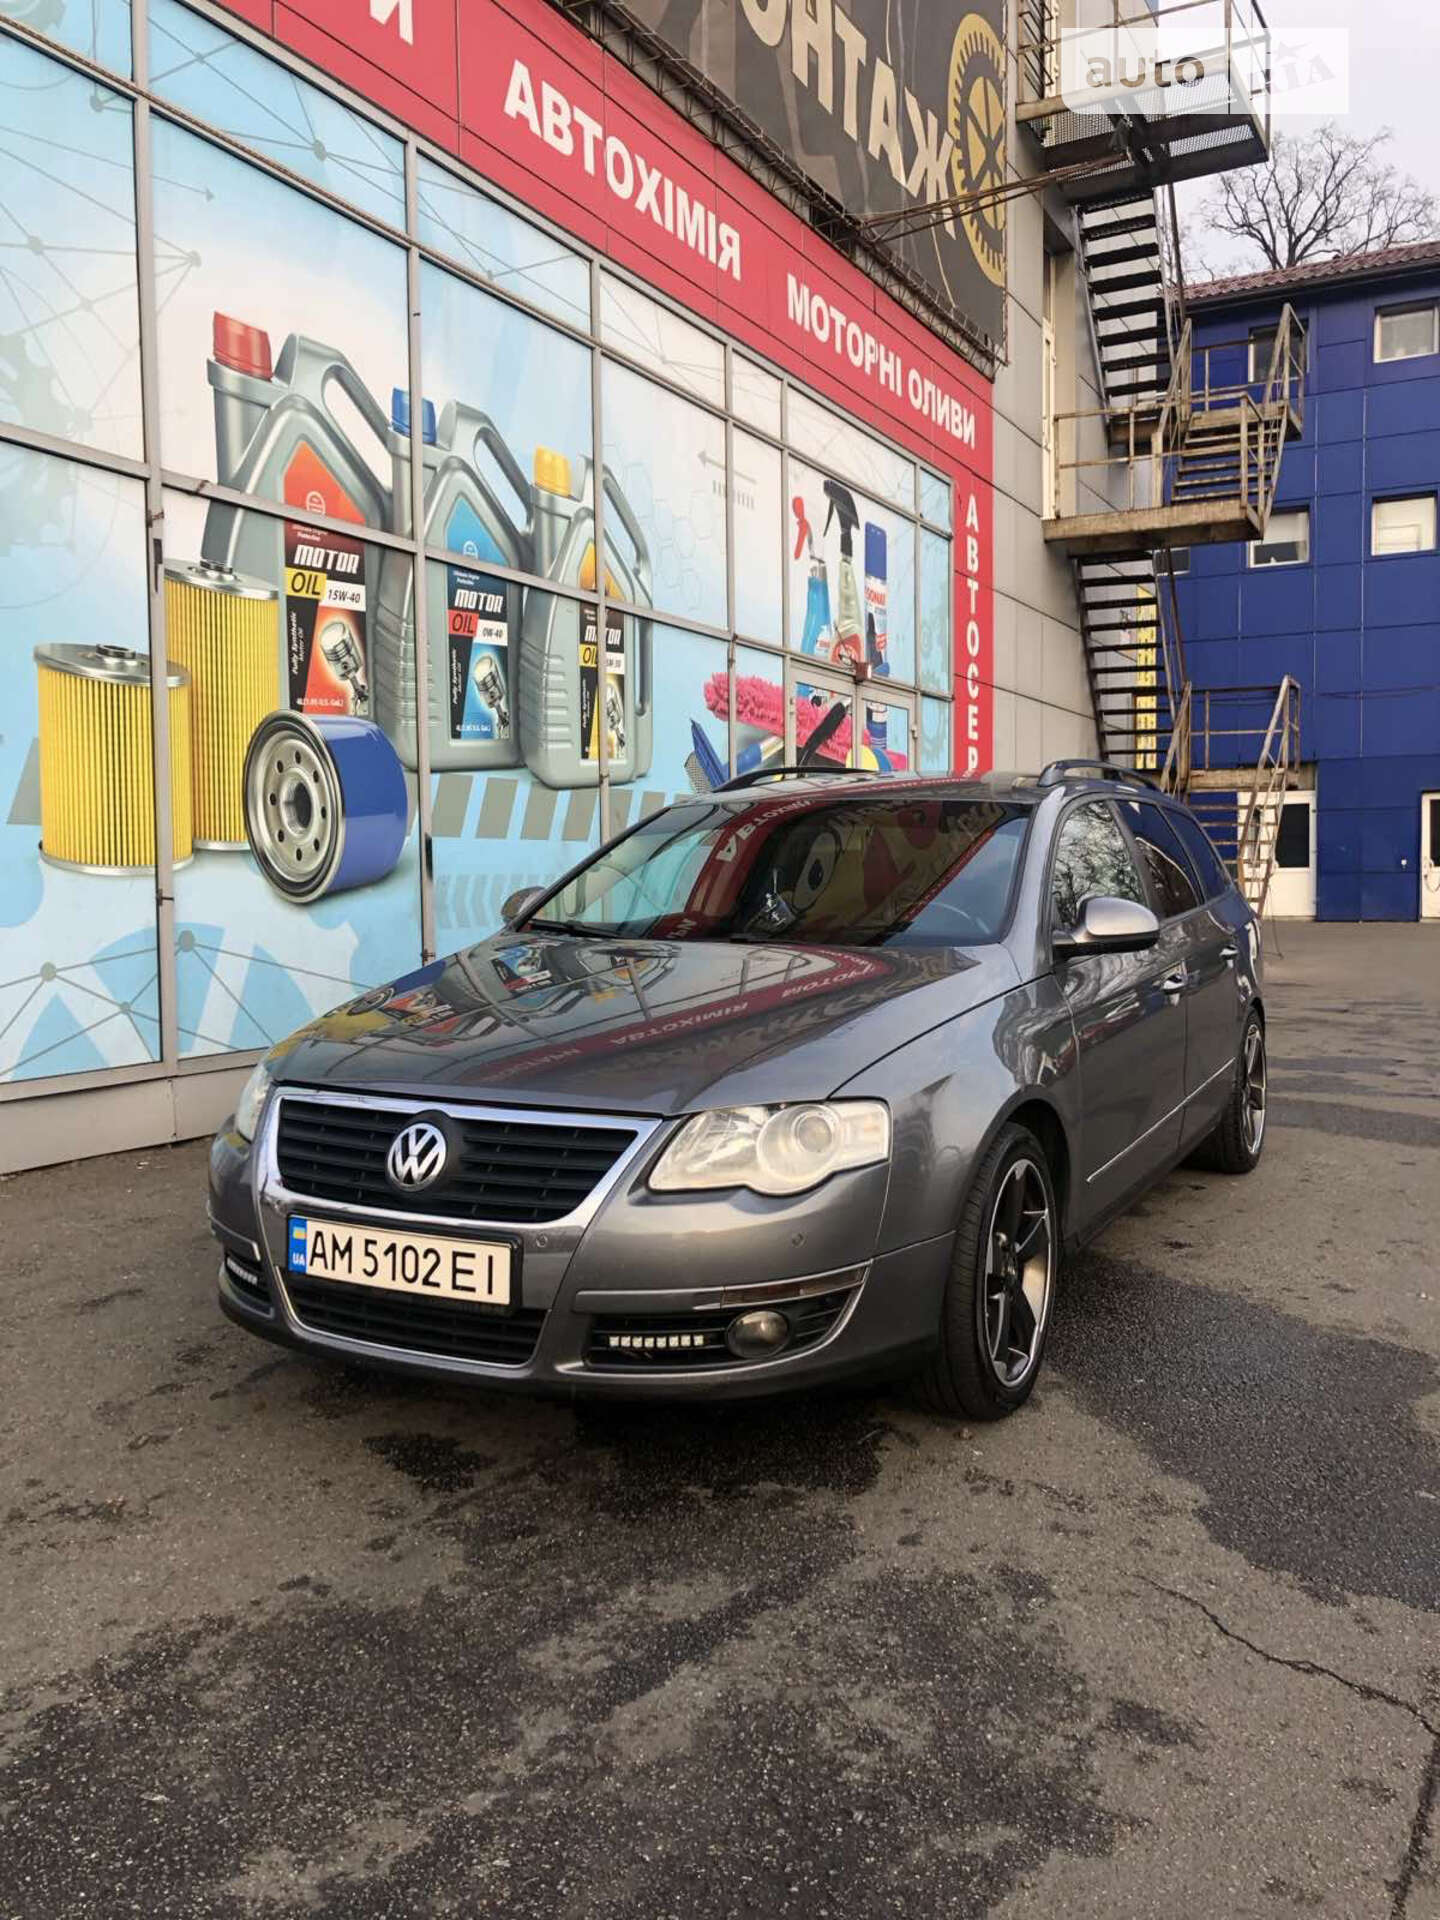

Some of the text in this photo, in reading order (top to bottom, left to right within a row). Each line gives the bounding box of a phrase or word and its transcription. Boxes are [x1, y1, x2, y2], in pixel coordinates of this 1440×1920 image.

[503, 58, 741, 282] АВТОХІМІЯ
[786, 272, 976, 451] МОТОРНІ ОЛИВИ
[293, 543, 360, 575] MOTOR
[291, 571, 321, 596] OIL
[327, 588, 361, 604] 15W-40
[454, 588, 504, 614] MOTOR
[452, 612, 474, 635] OIL
[584, 624, 622, 646] MOR
[387, 1122, 447, 1192] VW
[292, 1252, 306, 1266] UA
[309, 1230, 494, 1296] AM 5102 EI
